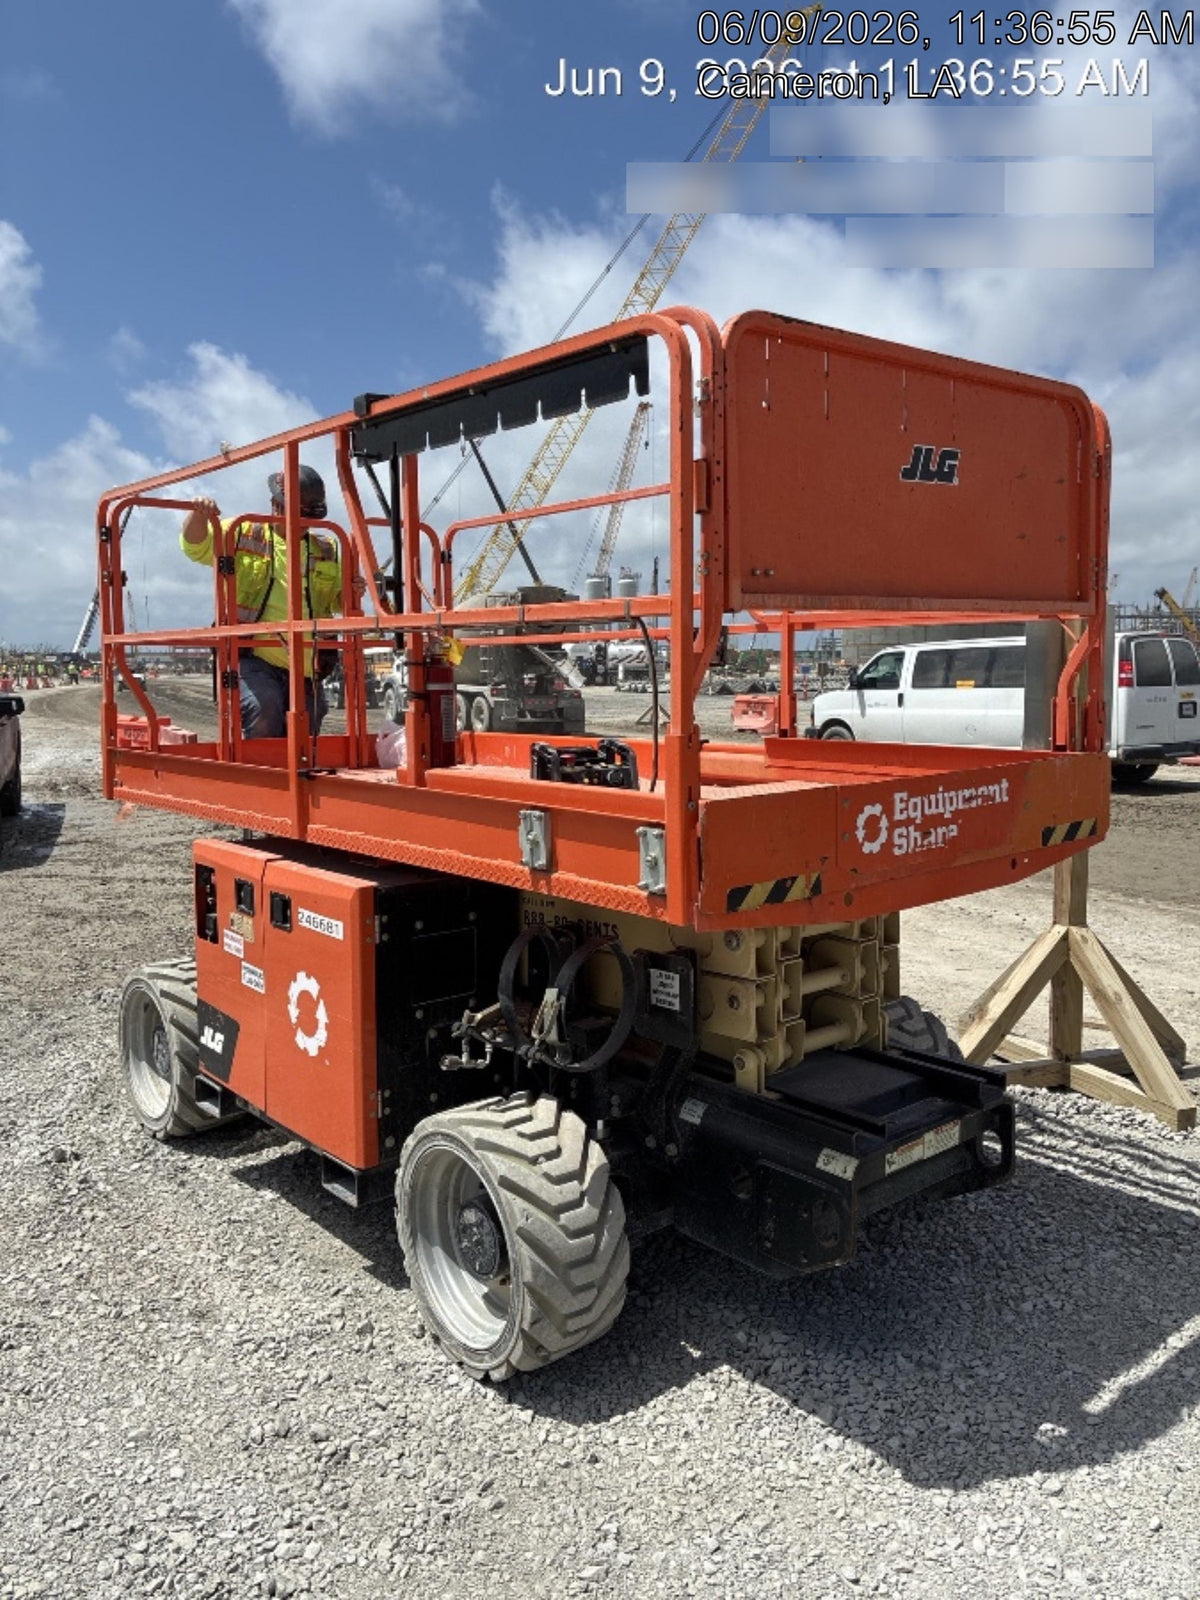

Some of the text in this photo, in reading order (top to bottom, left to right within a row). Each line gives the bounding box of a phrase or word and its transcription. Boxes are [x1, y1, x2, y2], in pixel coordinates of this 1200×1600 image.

[900, 444, 961, 485] JLG
[893, 778, 1009, 824] Equipment
[298, 911, 341, 936] 246681
[200, 1025, 224, 1053] JLG
